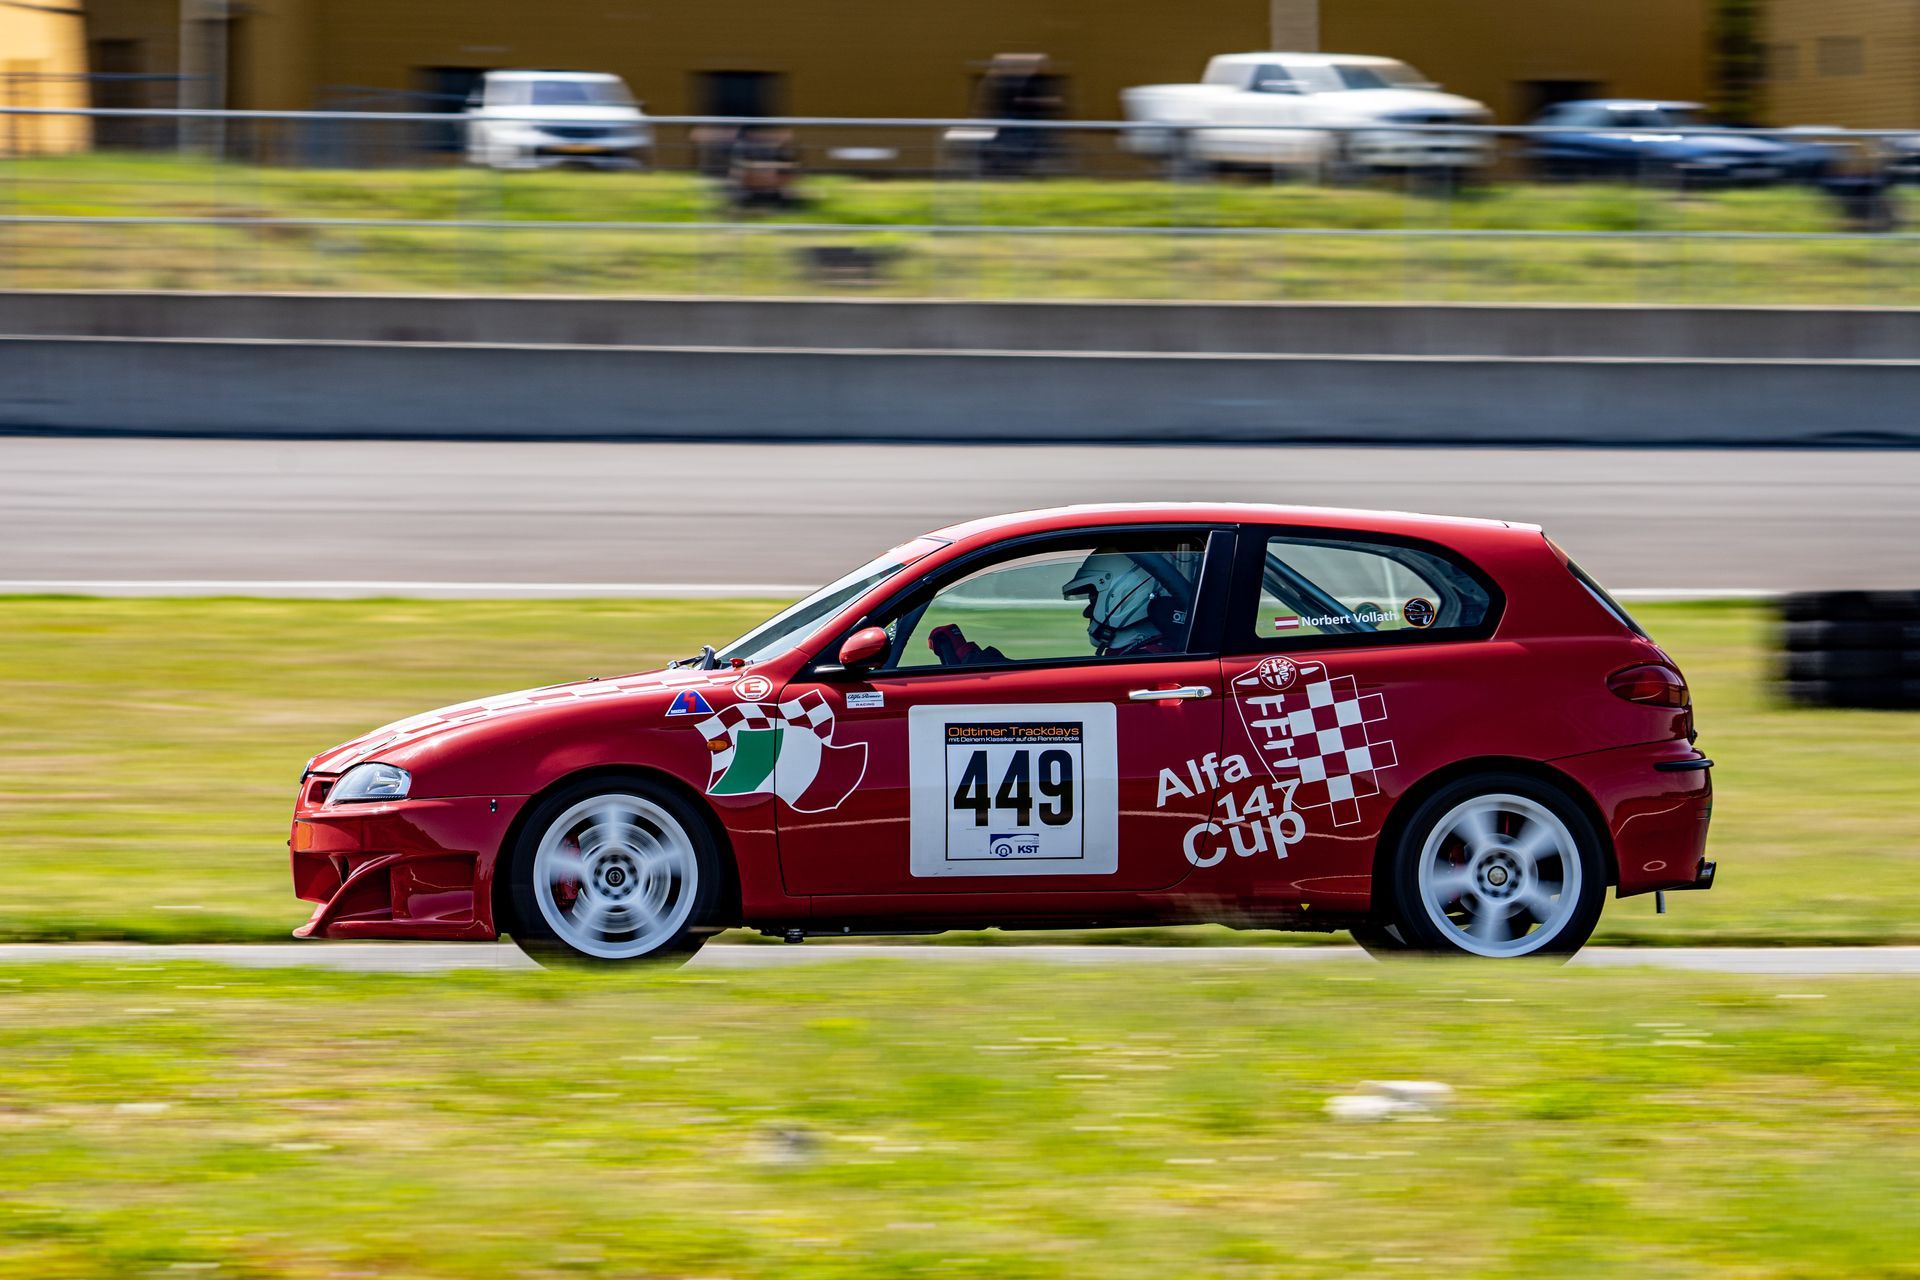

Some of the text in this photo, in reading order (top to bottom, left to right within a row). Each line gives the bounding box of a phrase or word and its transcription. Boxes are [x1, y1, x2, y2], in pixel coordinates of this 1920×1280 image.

[1301, 611, 1398, 627] Norbert Vollath
[744, 681, 762, 694] E
[948, 726, 1080, 737] Oldtimer Trackdays
[953, 749, 1074, 827] 449
[1156, 752, 1252, 808] Alfa
[1217, 778, 1301, 826] 147
[1017, 845, 1040, 854] KST
[1183, 810, 1306, 868] Cup
